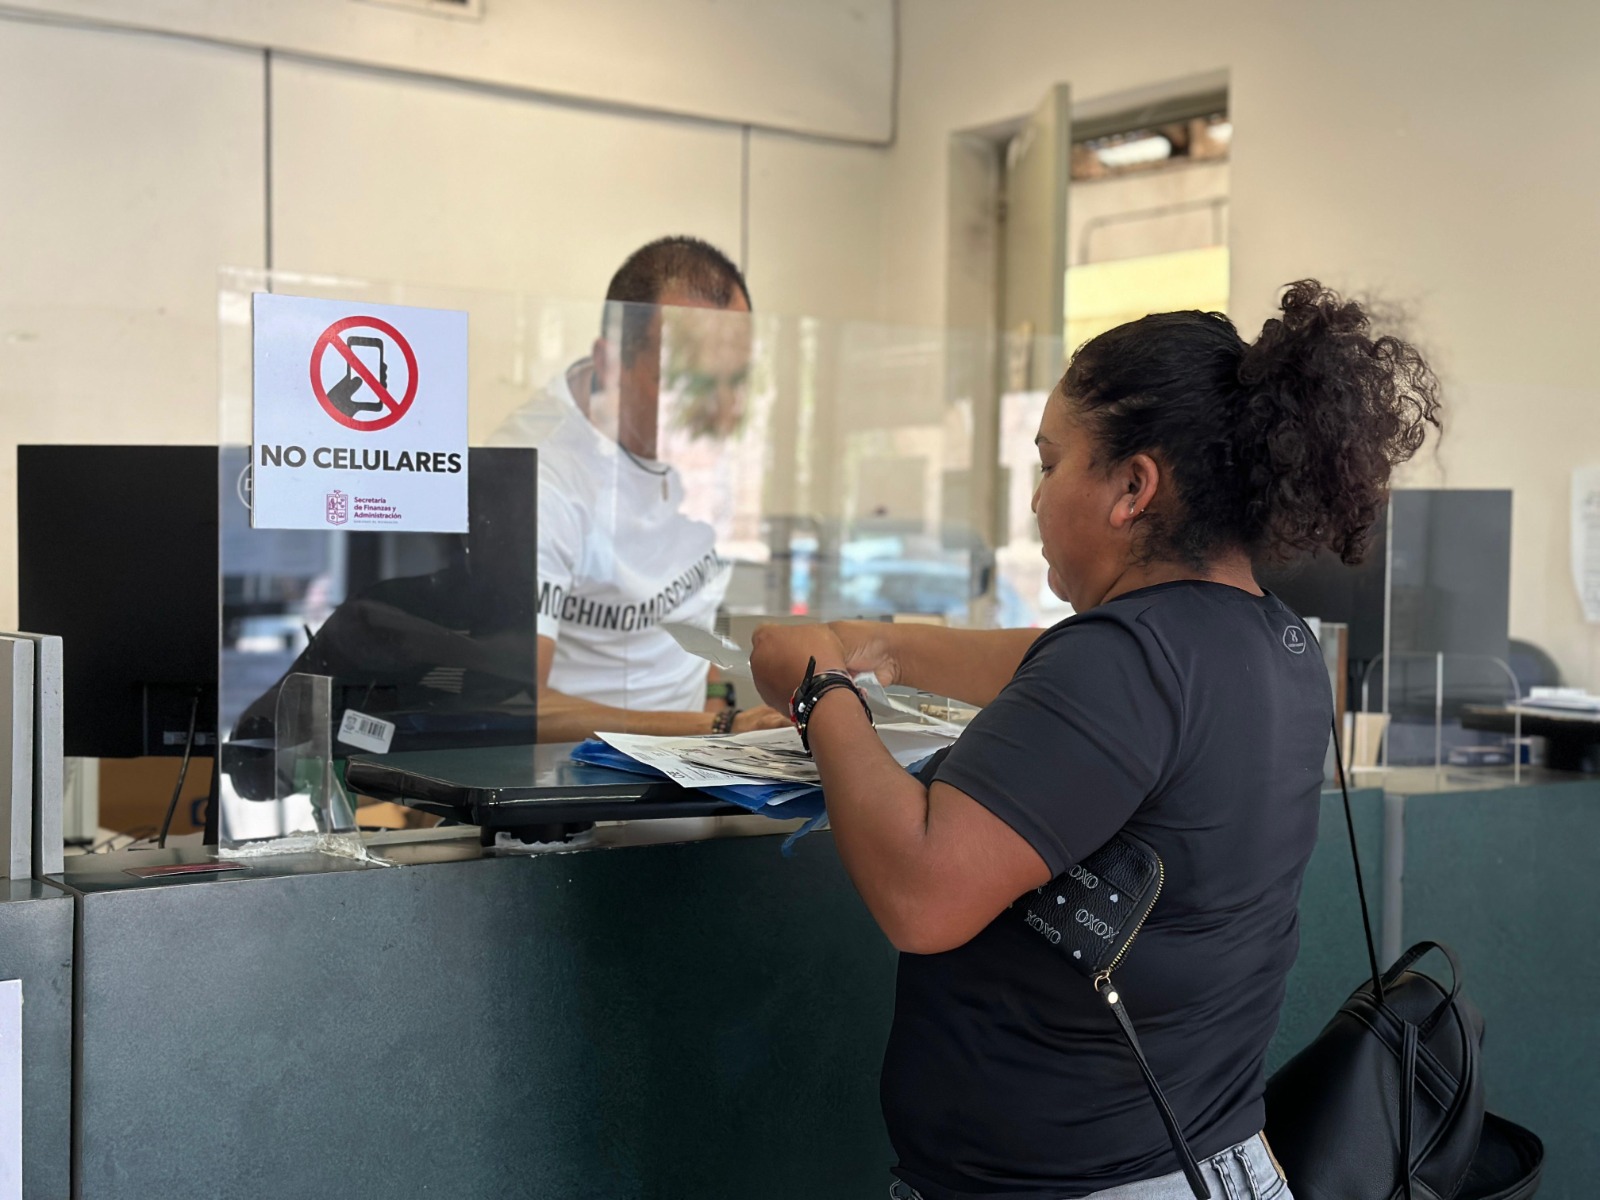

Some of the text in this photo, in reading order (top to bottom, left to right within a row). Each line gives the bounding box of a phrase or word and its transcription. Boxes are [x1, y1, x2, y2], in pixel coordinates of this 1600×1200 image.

[261, 445, 462, 473] NO CELULARES
[1069, 864, 1099, 889] OXO
[1024, 910, 1061, 945] XOXO
[1075, 909, 1119, 944] OXOX
